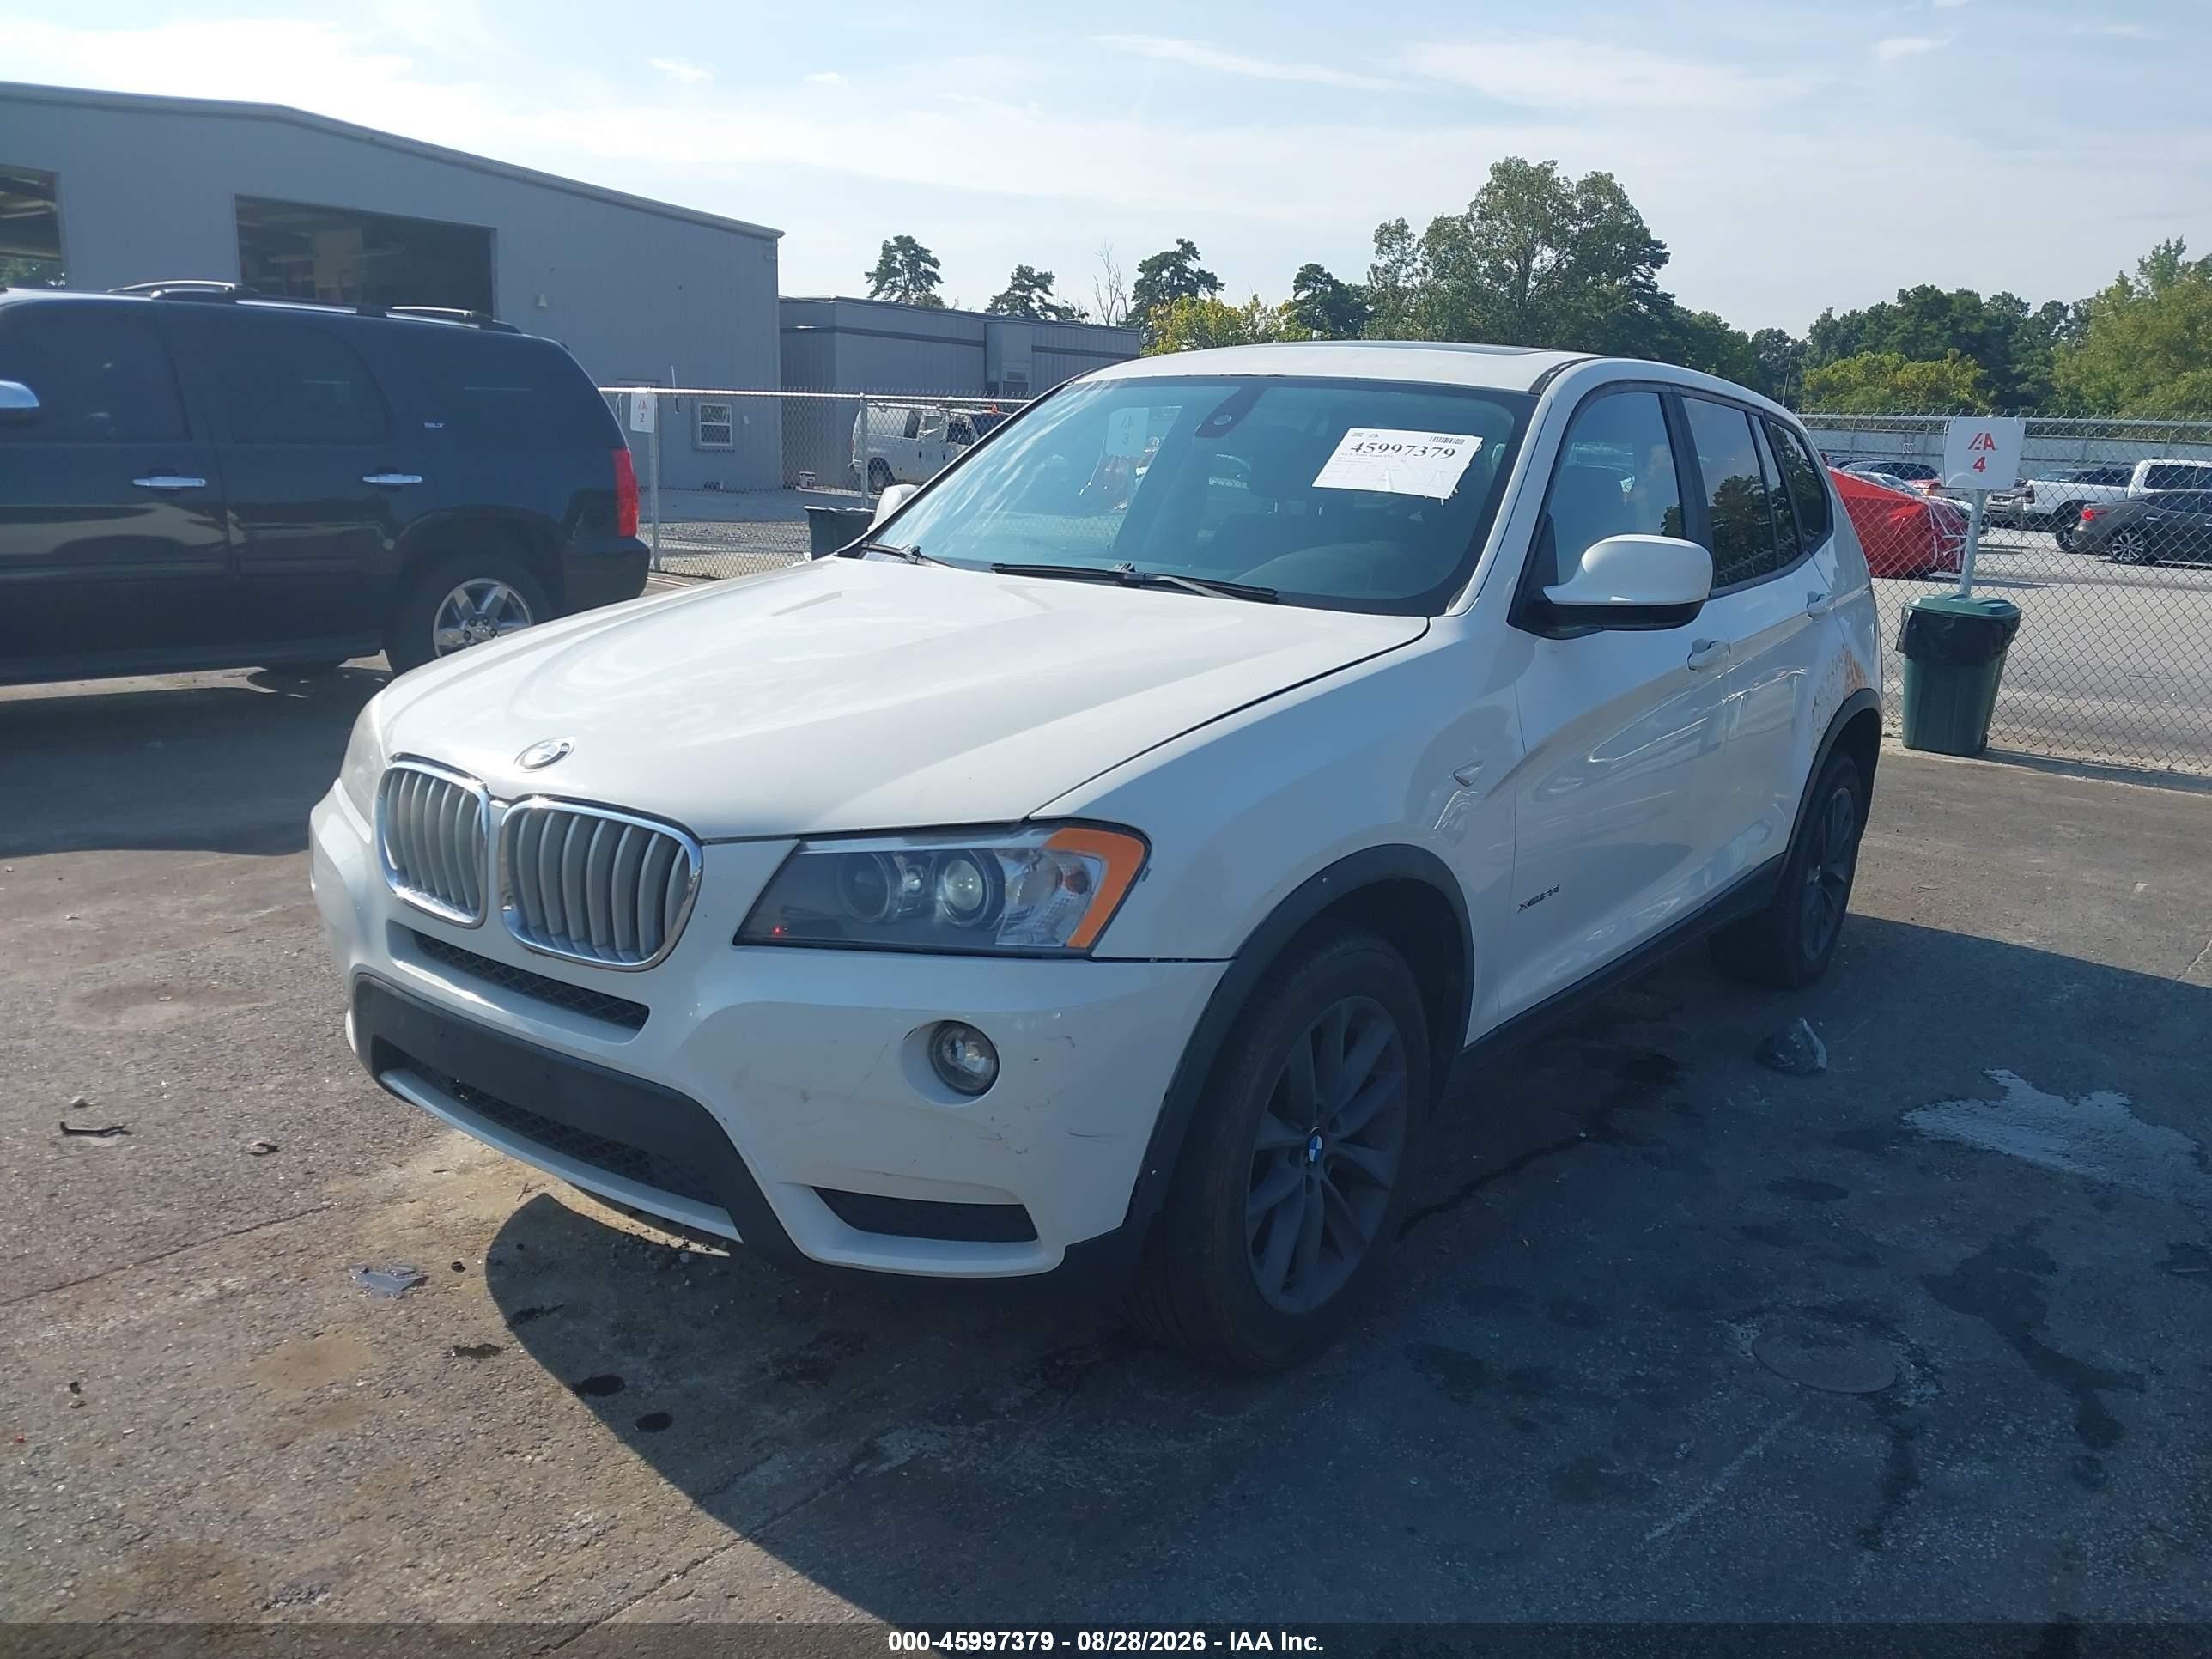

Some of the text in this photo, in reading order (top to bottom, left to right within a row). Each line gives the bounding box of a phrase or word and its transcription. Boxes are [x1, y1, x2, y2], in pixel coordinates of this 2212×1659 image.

[640, 413, 645, 422] 2
[1121, 433, 1130, 445] 3
[1350, 441, 1457, 459] 45997379
[1972, 456, 1986, 473] 4
